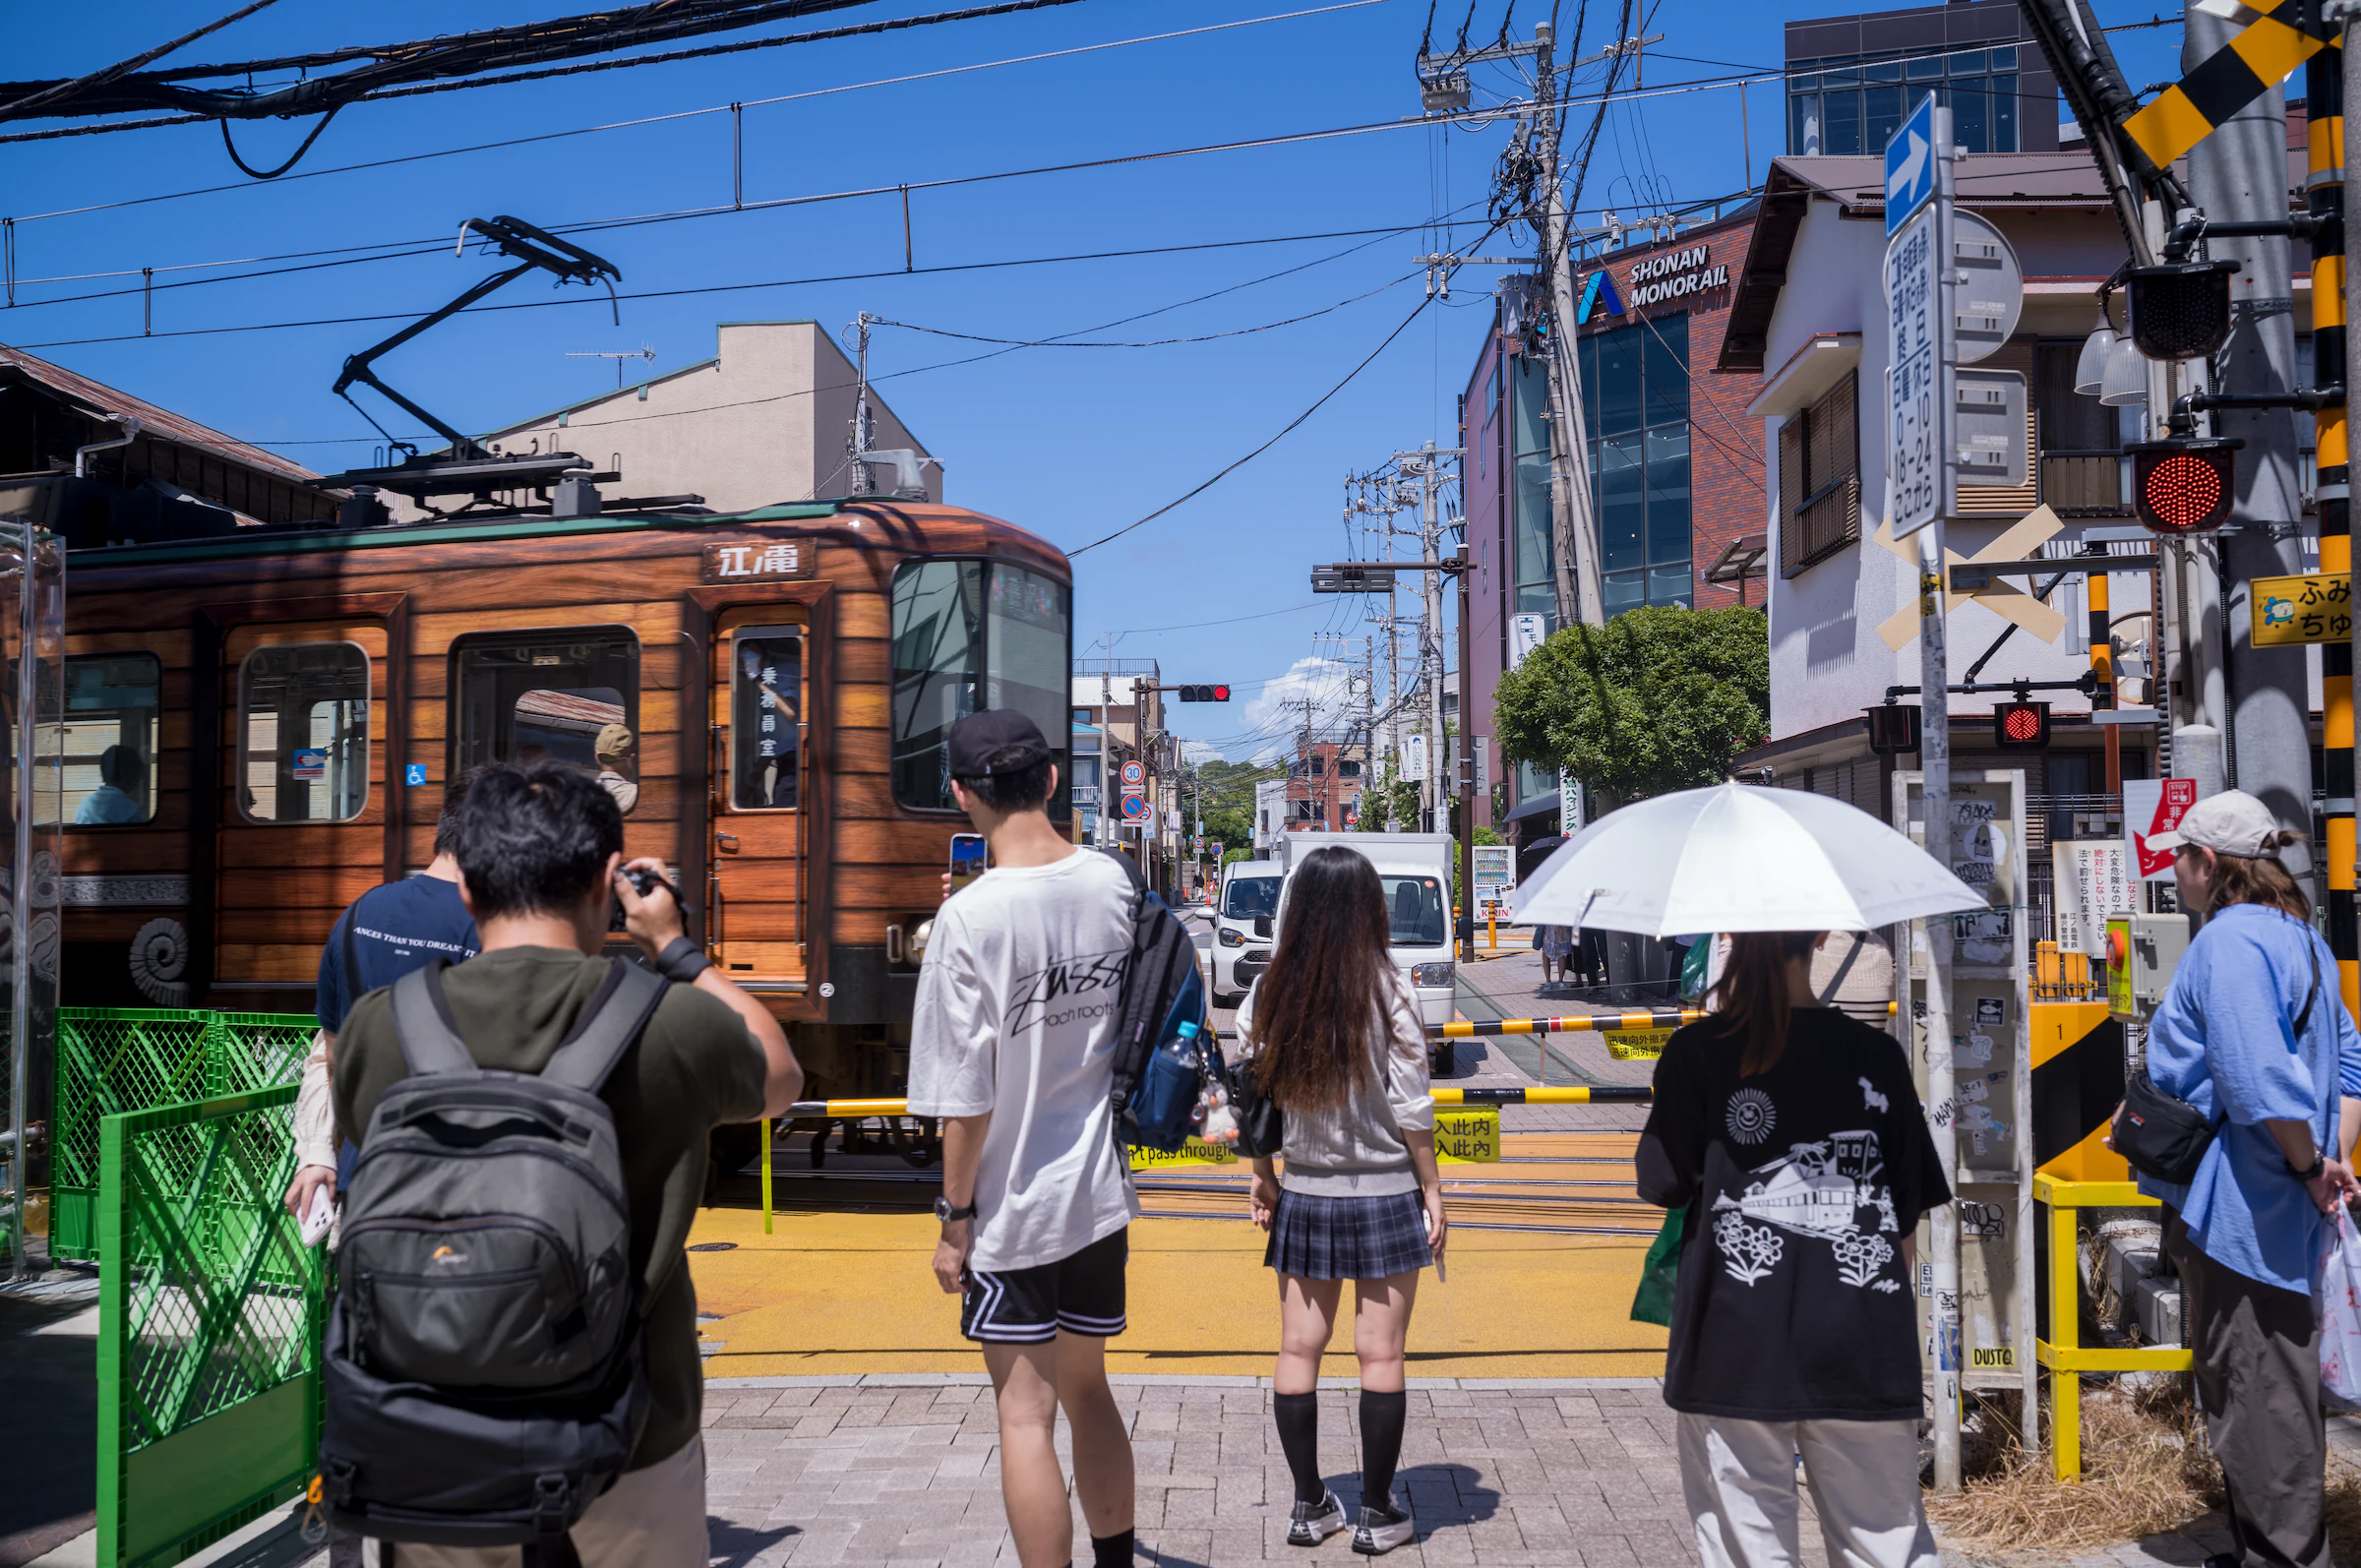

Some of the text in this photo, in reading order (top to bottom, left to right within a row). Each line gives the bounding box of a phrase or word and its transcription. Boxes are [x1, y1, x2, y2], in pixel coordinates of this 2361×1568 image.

[1629, 244, 1709, 283] SHONAN
[1630, 265, 1729, 309] MONORAIL
[1894, 470, 1932, 525] ここから
[719, 544, 799, 576] 江ノ電
[2299, 579, 2351, 605] ふみ
[759, 666, 777, 756] 乗務員室
[1126, 767, 1140, 778] 30
[408, 938, 427, 948] YOU
[1077, 1000, 1114, 1019] roots
[2056, 1023, 2063, 1040] 1
[1433, 1117, 1490, 1136] 入此内
[1180, 1141, 1232, 1161] through
